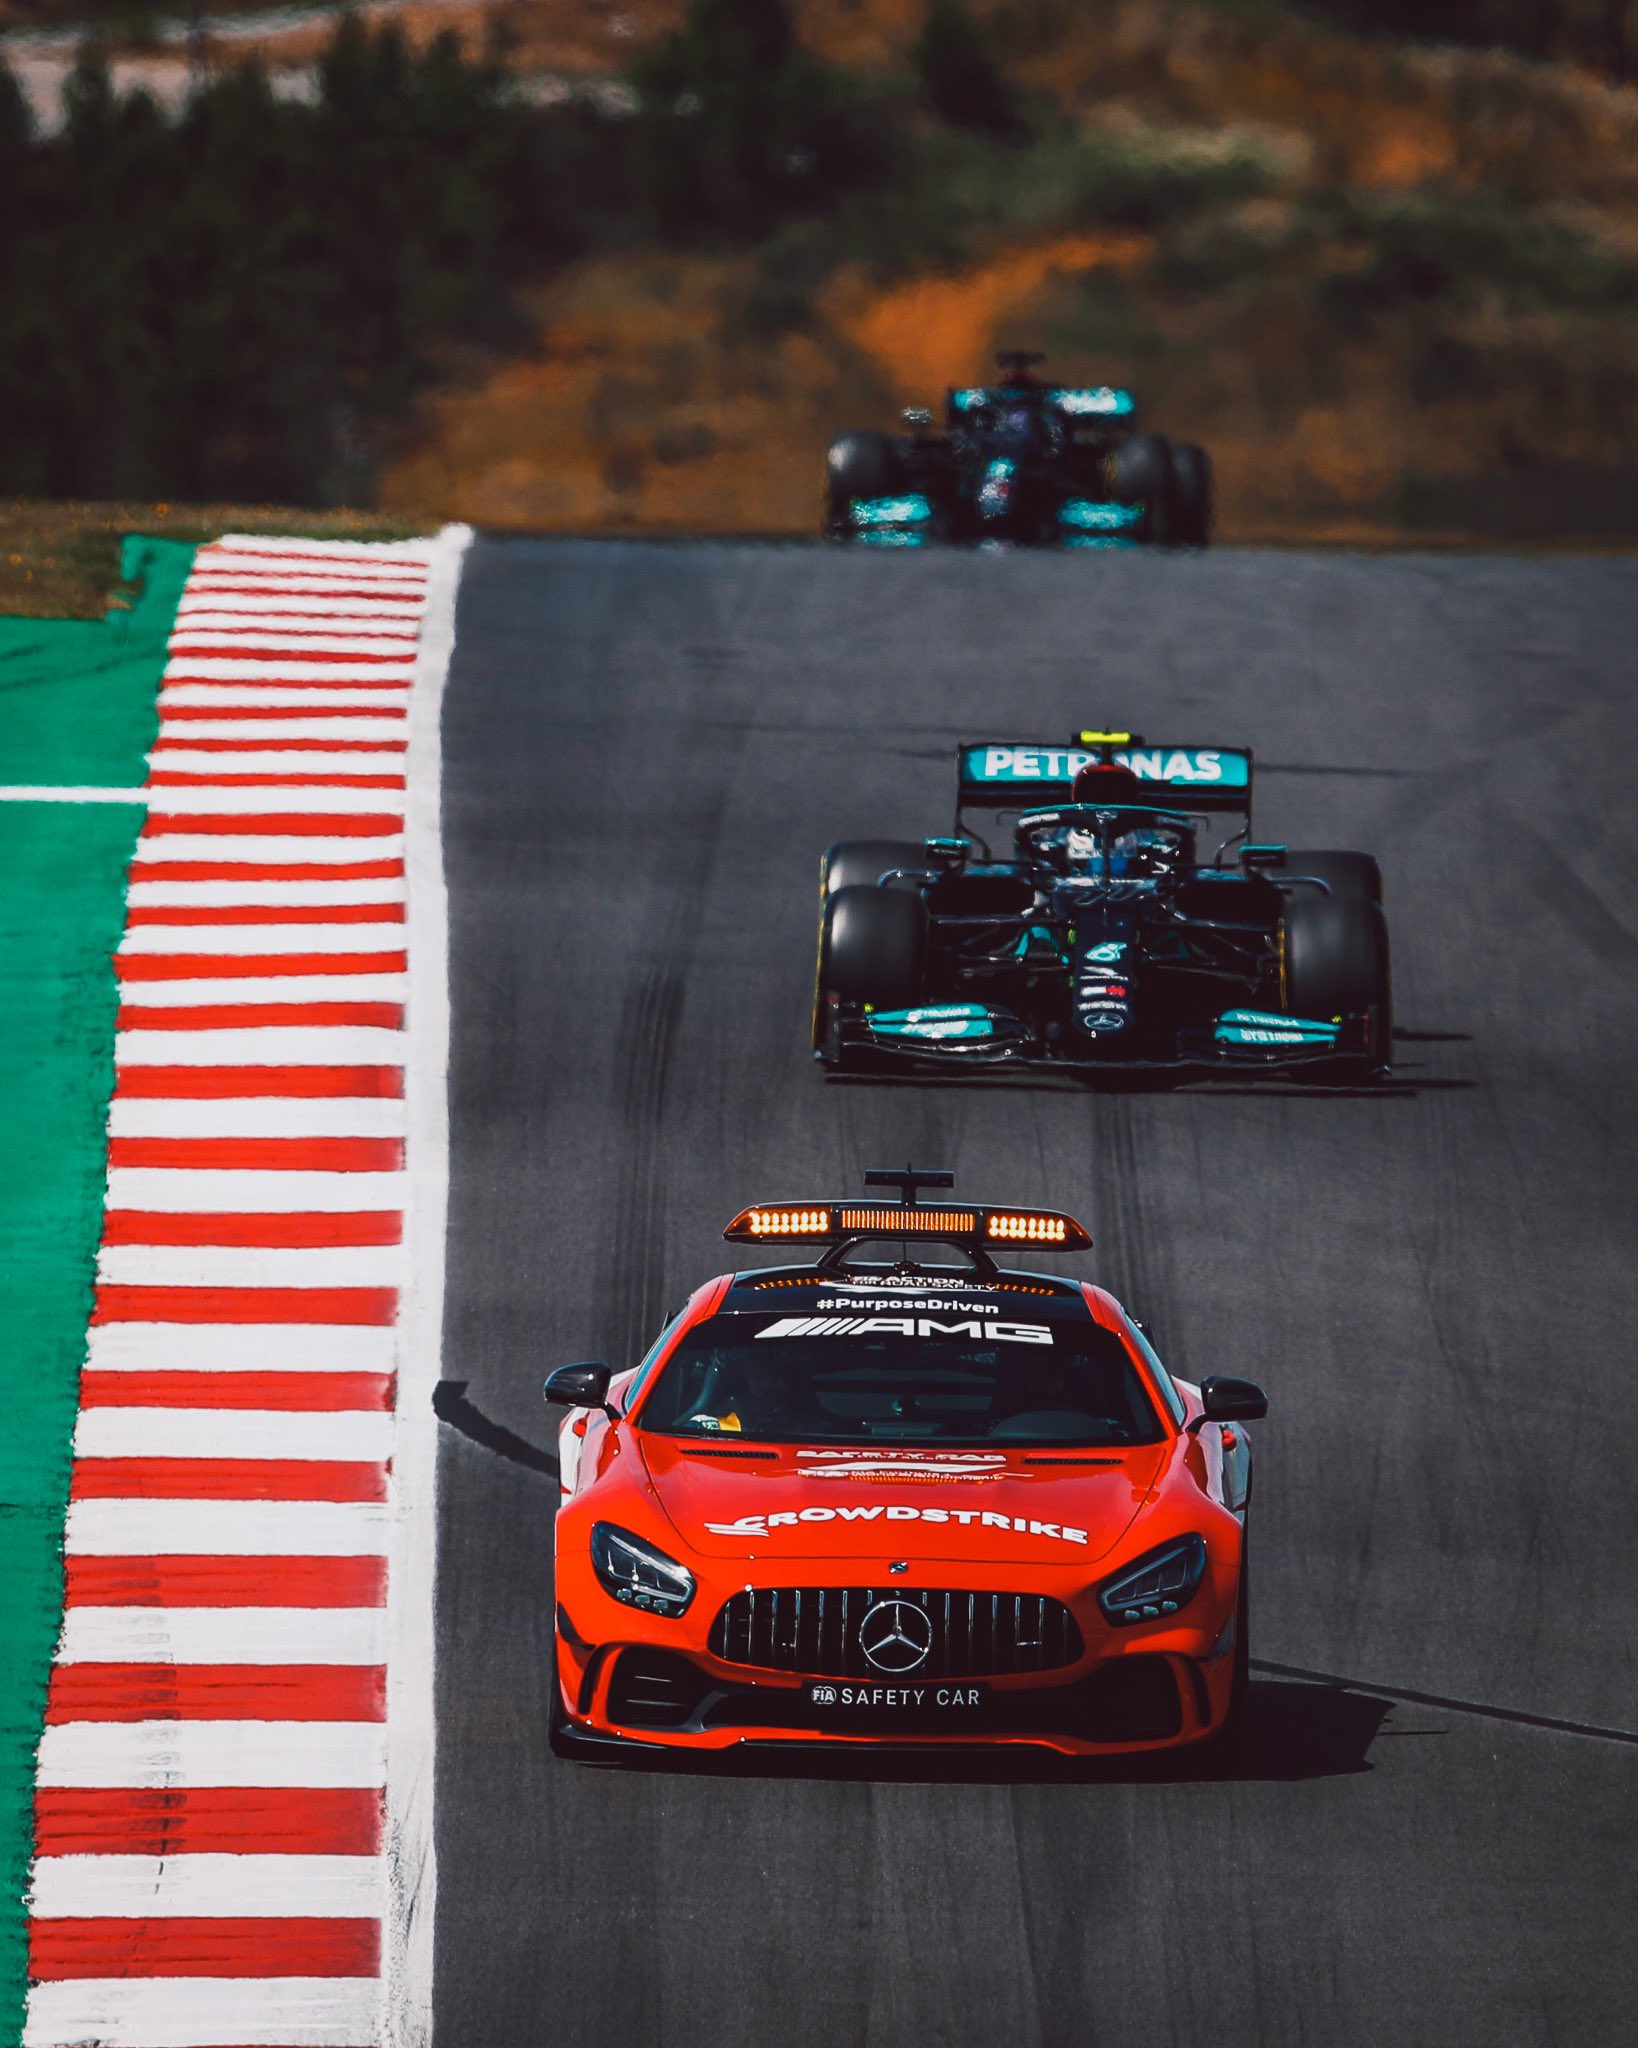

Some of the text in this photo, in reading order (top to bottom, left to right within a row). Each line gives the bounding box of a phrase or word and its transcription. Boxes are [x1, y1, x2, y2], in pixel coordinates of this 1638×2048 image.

[985, 750, 1221, 780] PETRNAS
[817, 1298, 999, 1314] #PurposeDriven
[848, 1318, 1054, 1345] AMG
[704, 1506, 1089, 1545] CROWDSTRIKE
[841, 1688, 925, 1705] SAFETY
[936, 1689, 980, 1706] CAR
